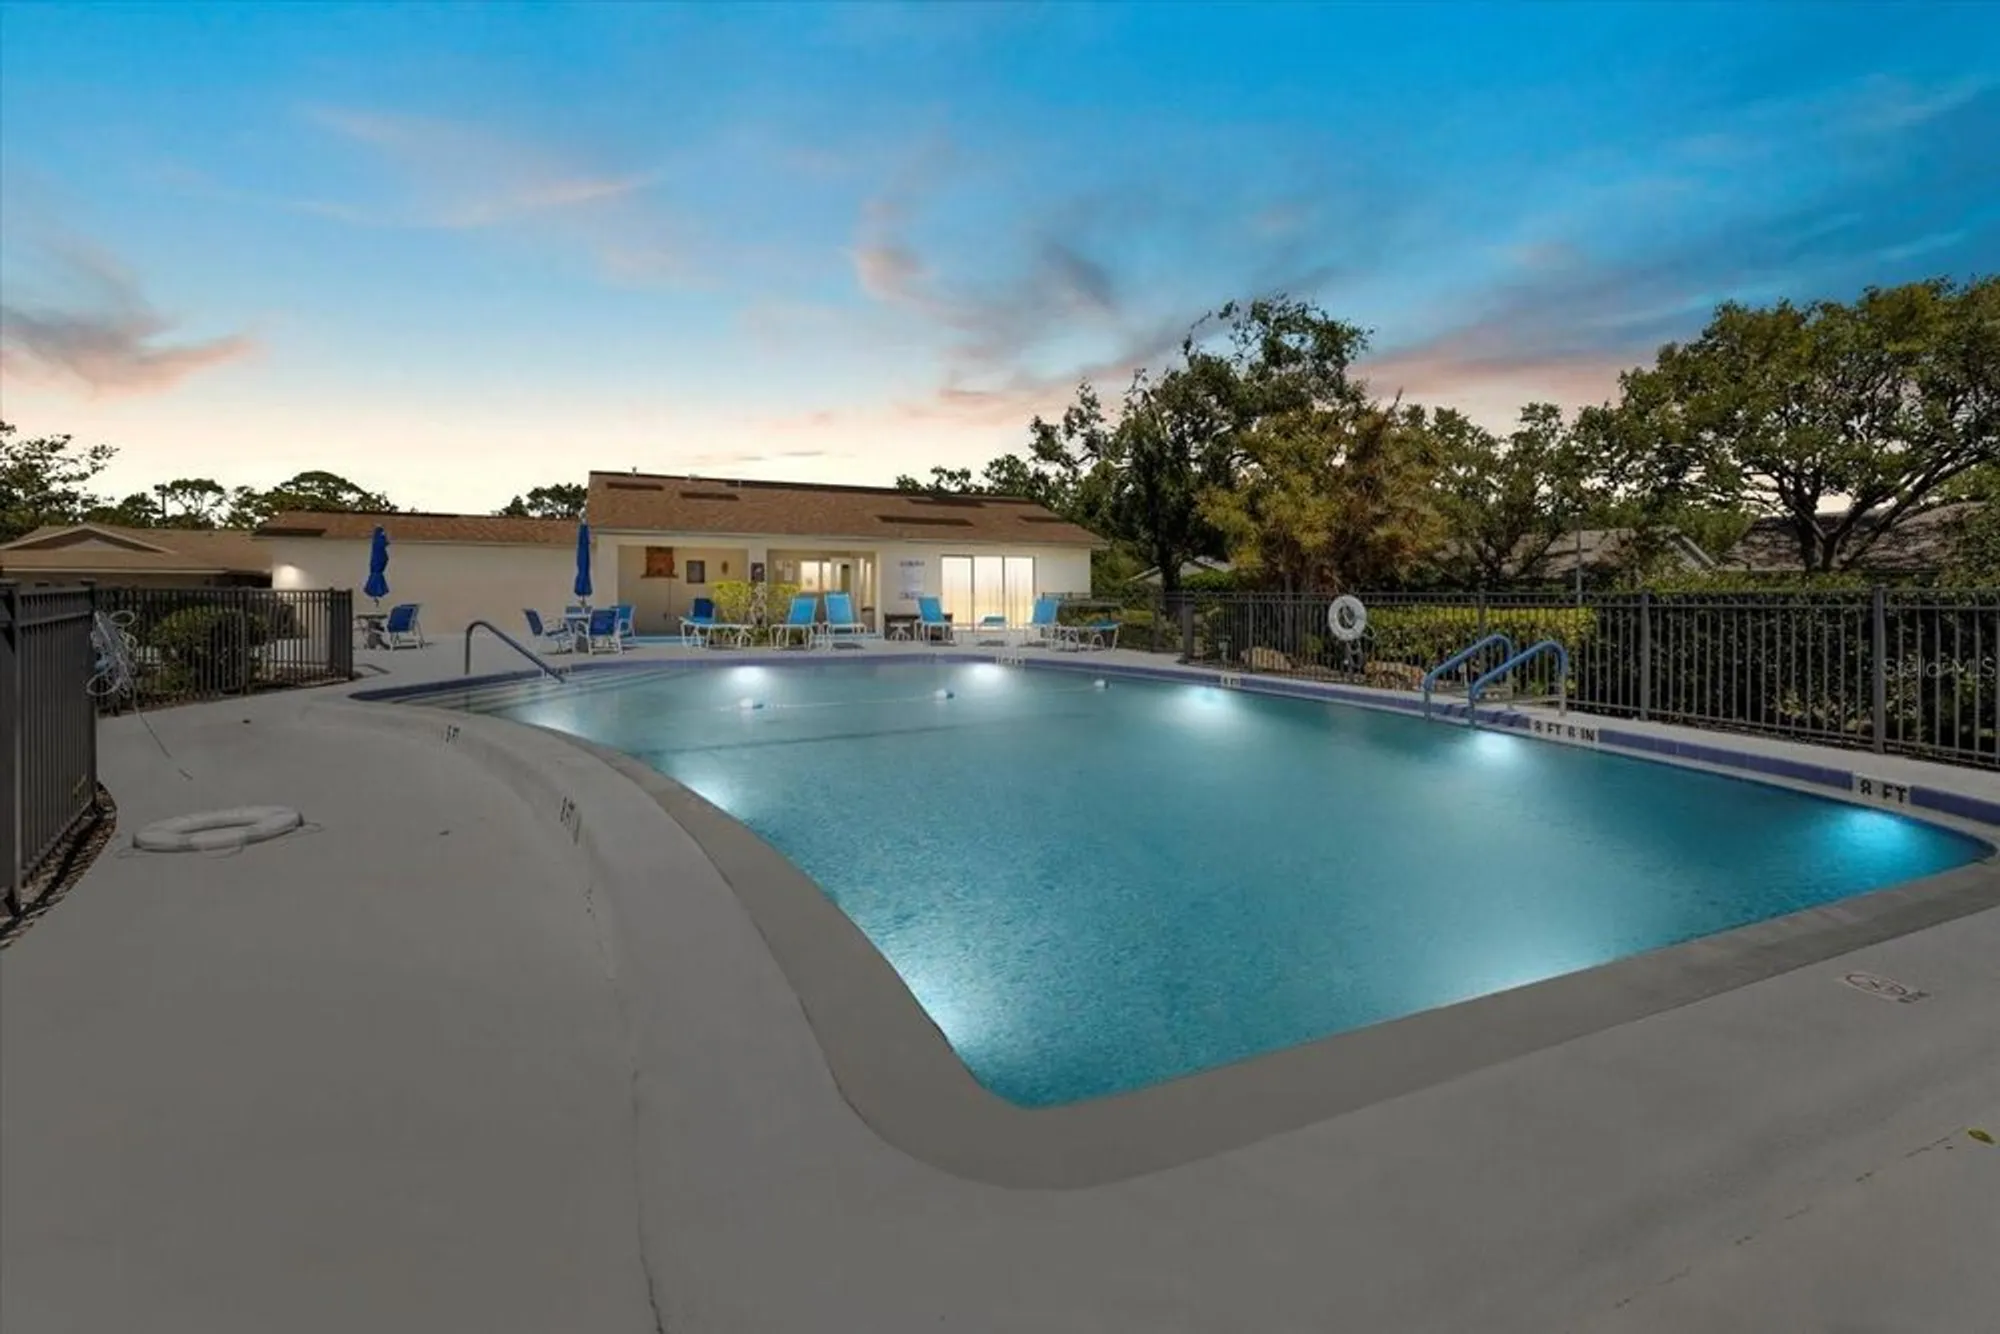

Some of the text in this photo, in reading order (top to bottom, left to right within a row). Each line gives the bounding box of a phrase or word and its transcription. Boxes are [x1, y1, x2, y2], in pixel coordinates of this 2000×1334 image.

[1547, 722, 1562, 736] FT
[1581, 728, 1596, 742] IN
[1882, 783, 1908, 804] FT
